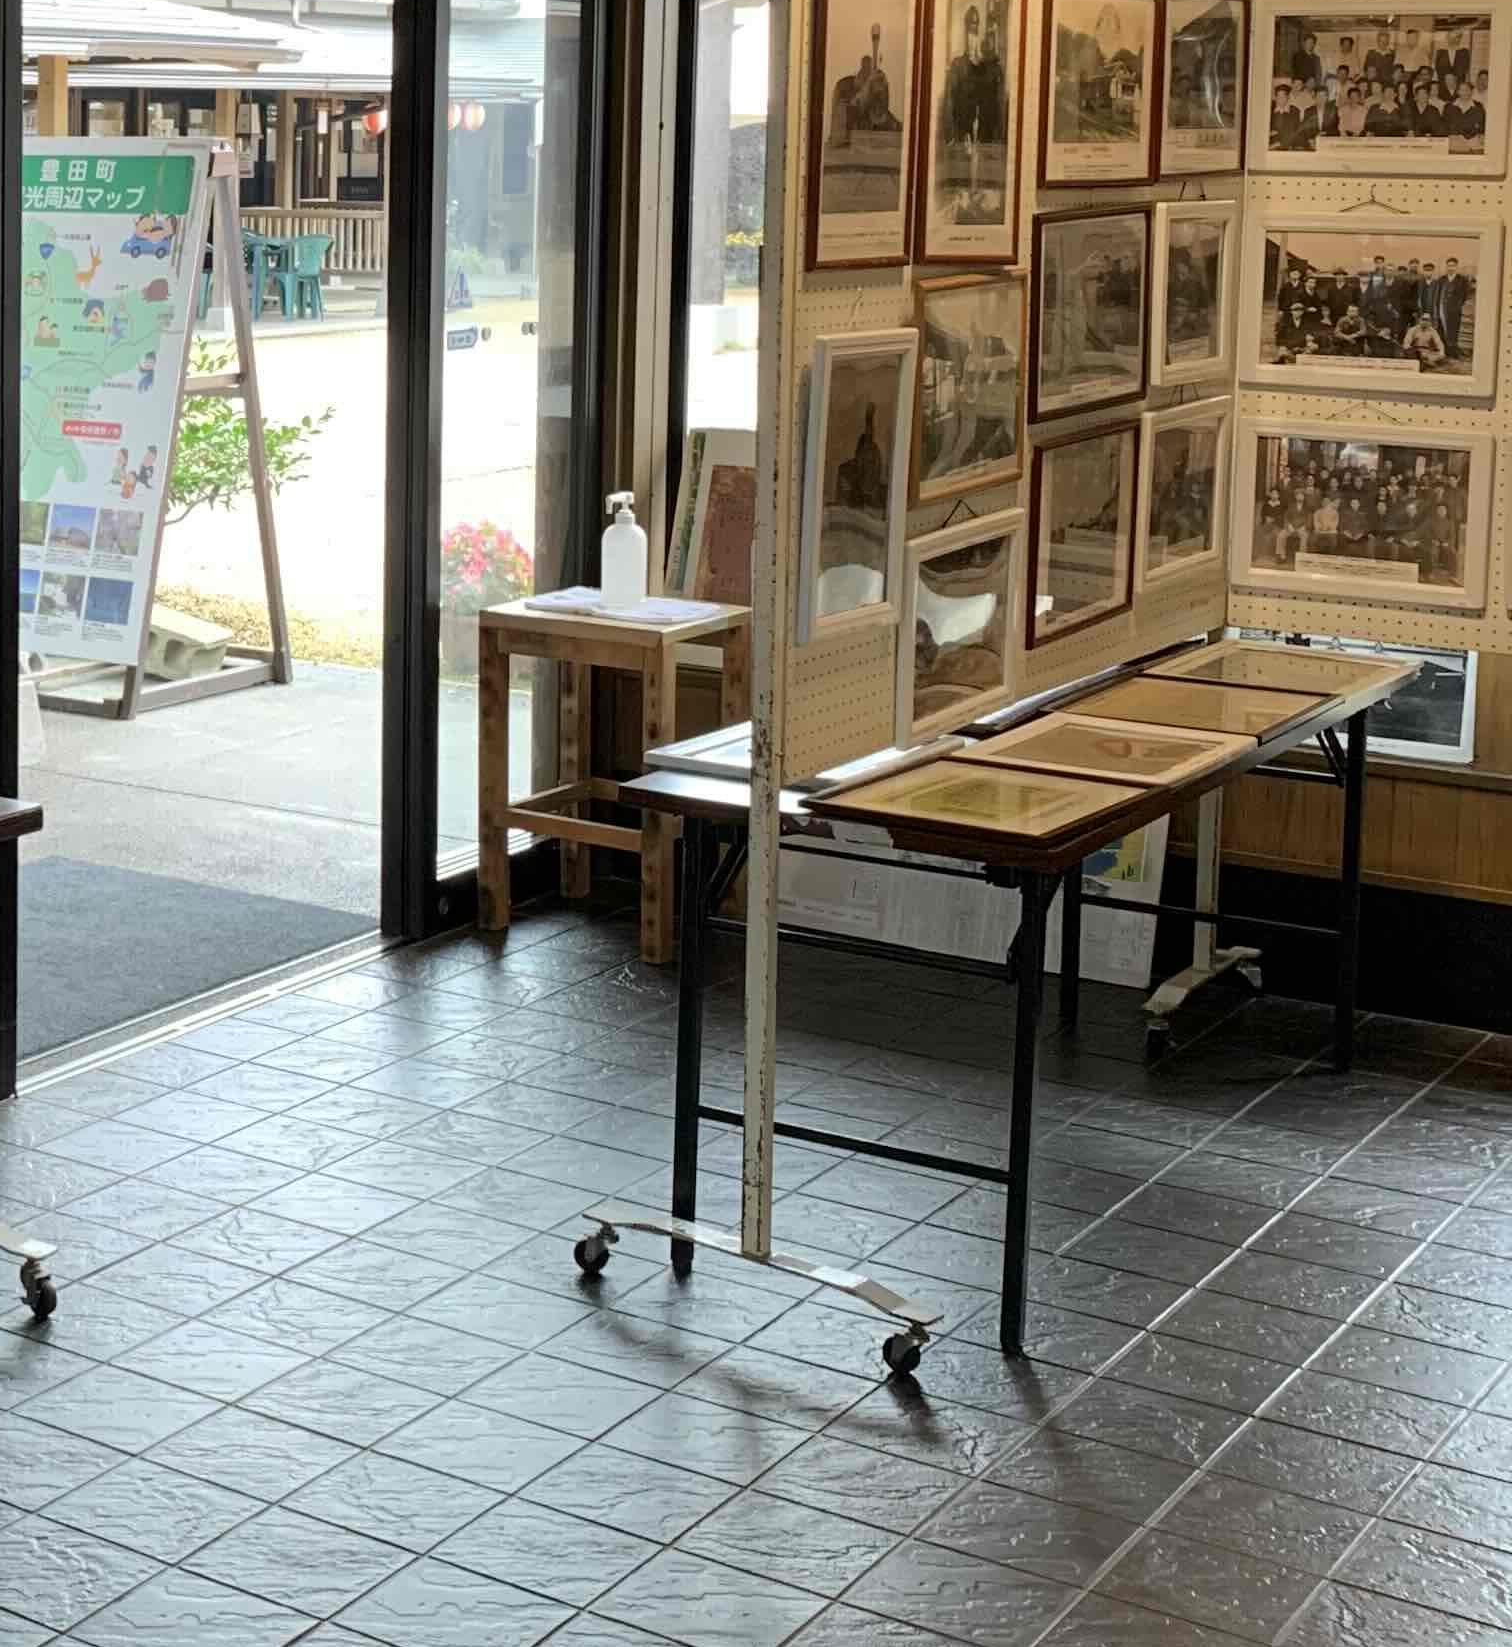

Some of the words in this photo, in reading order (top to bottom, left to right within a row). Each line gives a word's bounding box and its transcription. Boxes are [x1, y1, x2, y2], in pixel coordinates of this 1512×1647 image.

[22, 185, 146, 209] 光周辺マップ
